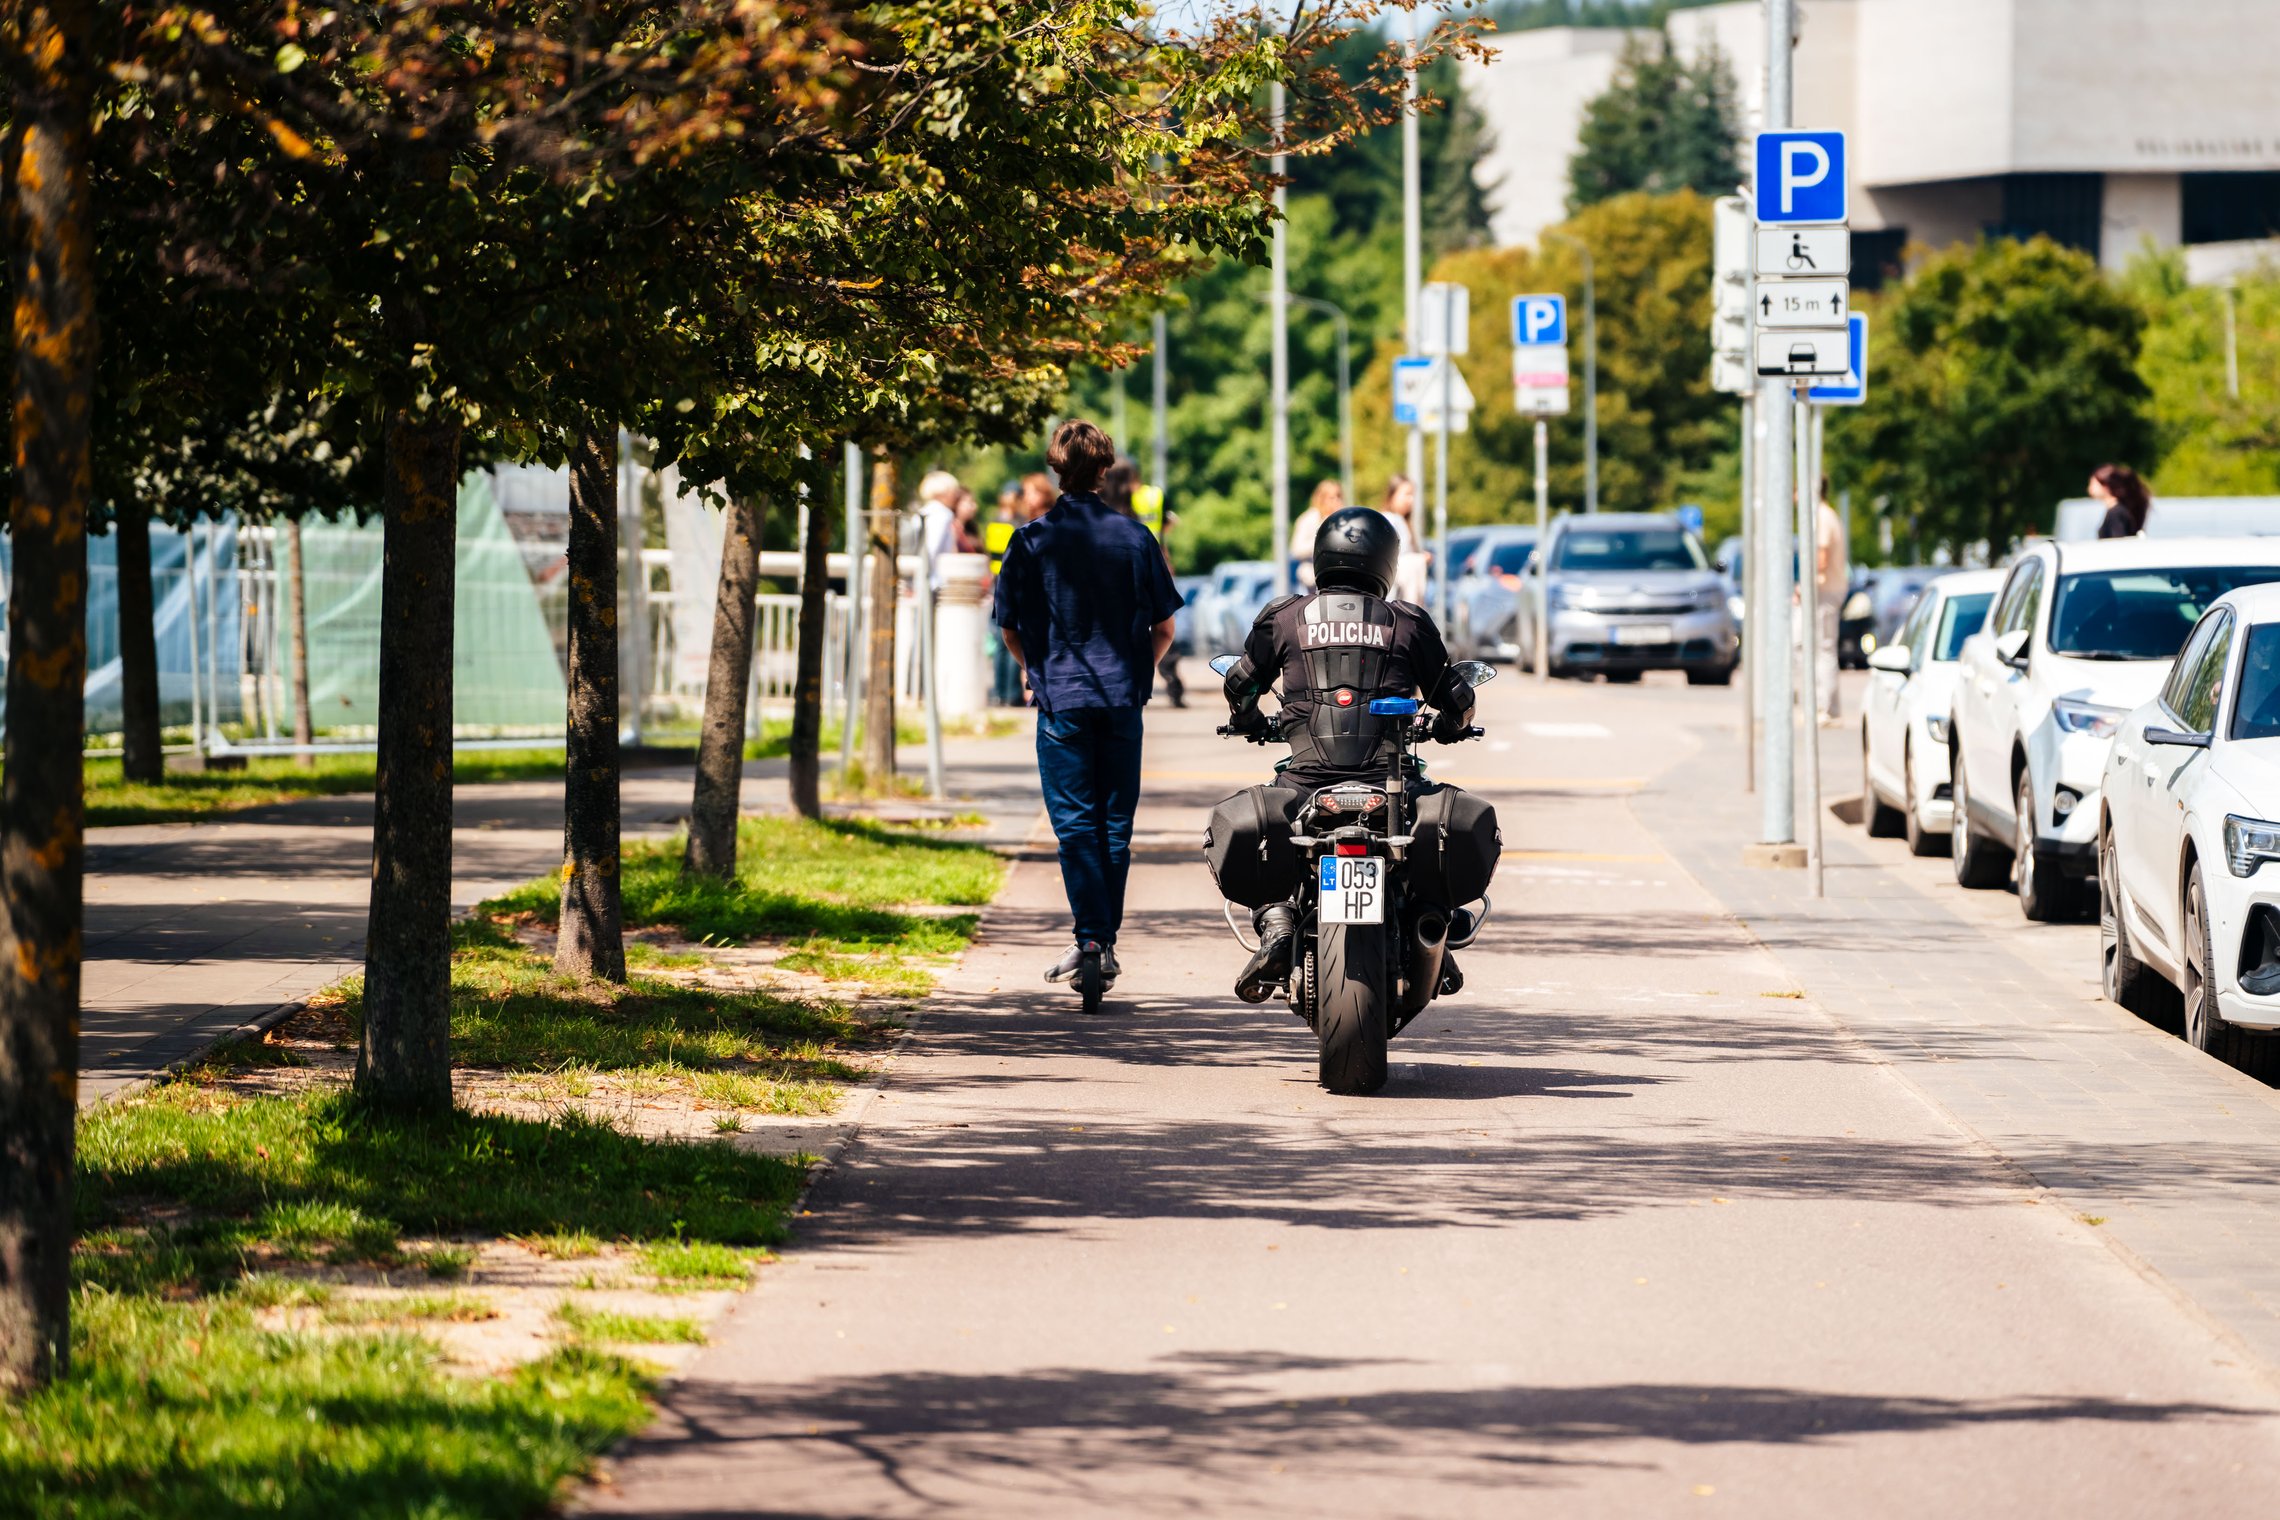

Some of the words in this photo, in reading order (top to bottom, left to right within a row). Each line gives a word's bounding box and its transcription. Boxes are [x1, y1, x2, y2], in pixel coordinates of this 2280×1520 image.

[1780, 141, 1830, 213] P
[1784, 296, 1801, 312] 15
[1805, 300, 1820, 312] m
[1526, 301, 1557, 343] P
[1307, 622, 1384, 647] POLICIJA
[1323, 878, 1335, 886] LT
[1341, 861, 1376, 889] 053
[1345, 891, 1373, 919] HP
